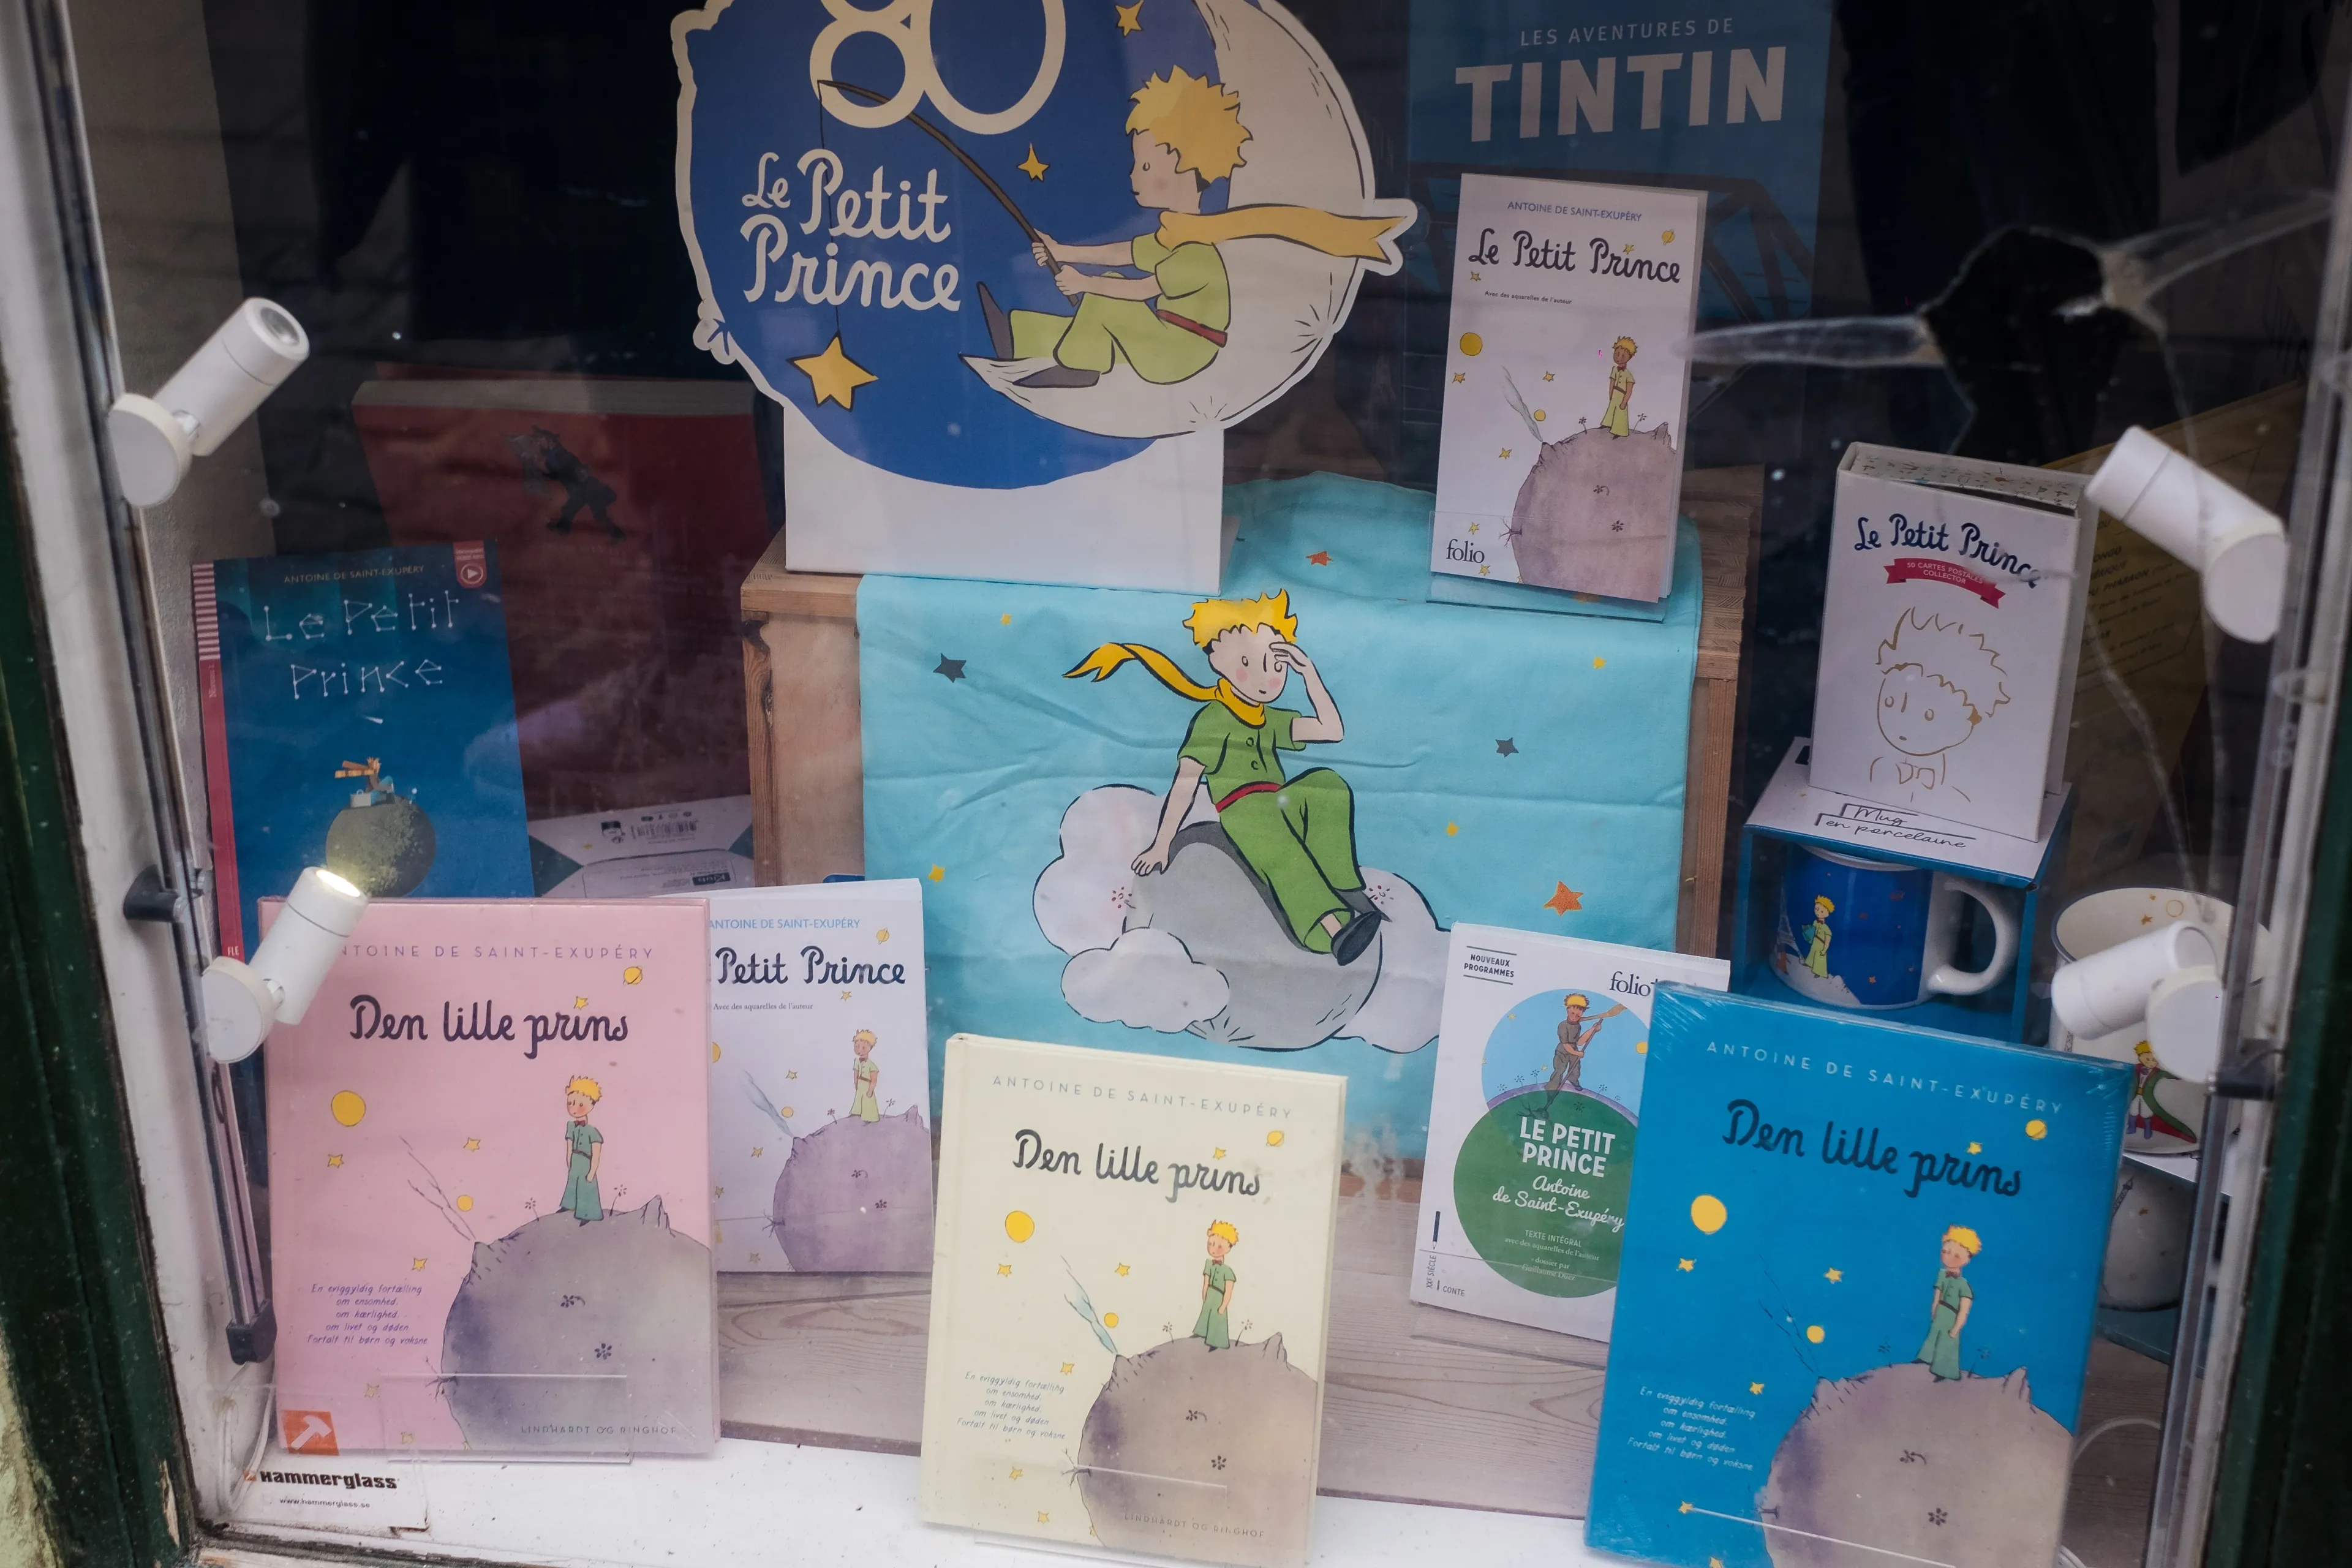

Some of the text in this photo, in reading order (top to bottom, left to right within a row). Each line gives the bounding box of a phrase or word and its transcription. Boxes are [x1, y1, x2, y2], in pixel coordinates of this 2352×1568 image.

[1520, 18, 1733, 47] LES AVENTURES DE
[810, 0, 1066, 135] 80
[1455, 47, 1786, 142] TINTIN
[742, 148, 951, 243] Le Petit
[1507, 202, 1642, 222] ANTOINE DE SAINT-EXUPÉRY
[740, 214, 961, 311] Prince
[1468, 228, 1681, 284] Le Petit Prince
[1511, 293, 1539, 302] aquarelles
[1446, 538, 1485, 564] folio
[1854, 513, 2041, 589] Le Petit Prince
[284, 565, 425, 583] ANTOINE DE SAINT-EXUPÉRY
[1918, 562, 1947, 572] CARTES
[1948, 567, 1984, 584] POSTALES
[1923, 570, 1967, 584] COLLECTOR
[263, 589, 459, 641] Le Petit
[290, 658, 443, 699] Prince
[1854, 806, 1909, 826] Mug
[1826, 819, 1966, 848] en porcelaine
[709, 917, 860, 930] ANTOINE DE SAINT-EXUPÉRY
[227, 946, 239, 956] FLE
[342, 944, 654, 960] NTOINE DE SAINT-EXUPÉRY
[1470, 954, 1510, 967] NOUVEAUX
[715, 945, 905, 985] Petit Prince
[1463, 962, 1514, 978] PROGRAMMES
[744, 1003, 777, 1012] aquarelles
[349, 994, 628, 1059] Den lille prins
[1706, 1041, 2062, 1115] ANTOINE DE SAINT-EXUPÉRY
[992, 1076, 1292, 1119] ANTOINE DE SAINT-EXUPÉRY
[1520, 1117, 1616, 1155] LE PETIT
[1722, 1098, 2021, 1198] Den lille prins
[1012, 1129, 1261, 1203] Den lille prins
[1522, 1142, 1606, 1178] PRINCE
[1532, 1175, 1590, 1199] Antoine
[1492, 1185, 1624, 1233] de Saint-Exupéry
[1520, 1238, 1531, 1248] des
[1531, 1243, 1564, 1254] aquarelles
[1525, 1229, 1581, 1248] TEXTE INTÉGRAL
[1427, 1255, 1436, 1276] SIÈCLE
[1535, 1257, 1558, 1267] dossier
[311, 1283, 422, 1296] En eviggyldig fortælling
[1442, 1285, 1465, 1296] CONTE
[368, 1325, 377, 1333] og
[307, 1334, 428, 1347] Fortalt til børn og voksne
[979, 1374, 1021, 1389] eviggyldig
[1025, 1380, 1065, 1394] fortælling
[1640, 1385, 1653, 1396] En
[991, 1411, 1008, 1420] livet
[1011, 1415, 1021, 1424] og
[521, 1425, 590, 1434] LINDHARDT
[957, 1417, 985, 1429] Fortalt
[1003, 1424, 1022, 1434] børn
[1026, 1428, 1036, 1438] og
[1040, 1431, 1066, 1439] voksne
[1627, 1436, 1754, 1471] Fortalt til børn og voksne
[1691, 1439, 1703, 1450] og
[260, 1471, 398, 1489] Hammerglass
[279, 1498, 371, 1508] www.hammerglass.se
[1125, 1513, 1186, 1528] LINDHARDT
[1192, 1522, 1208, 1531] OG
